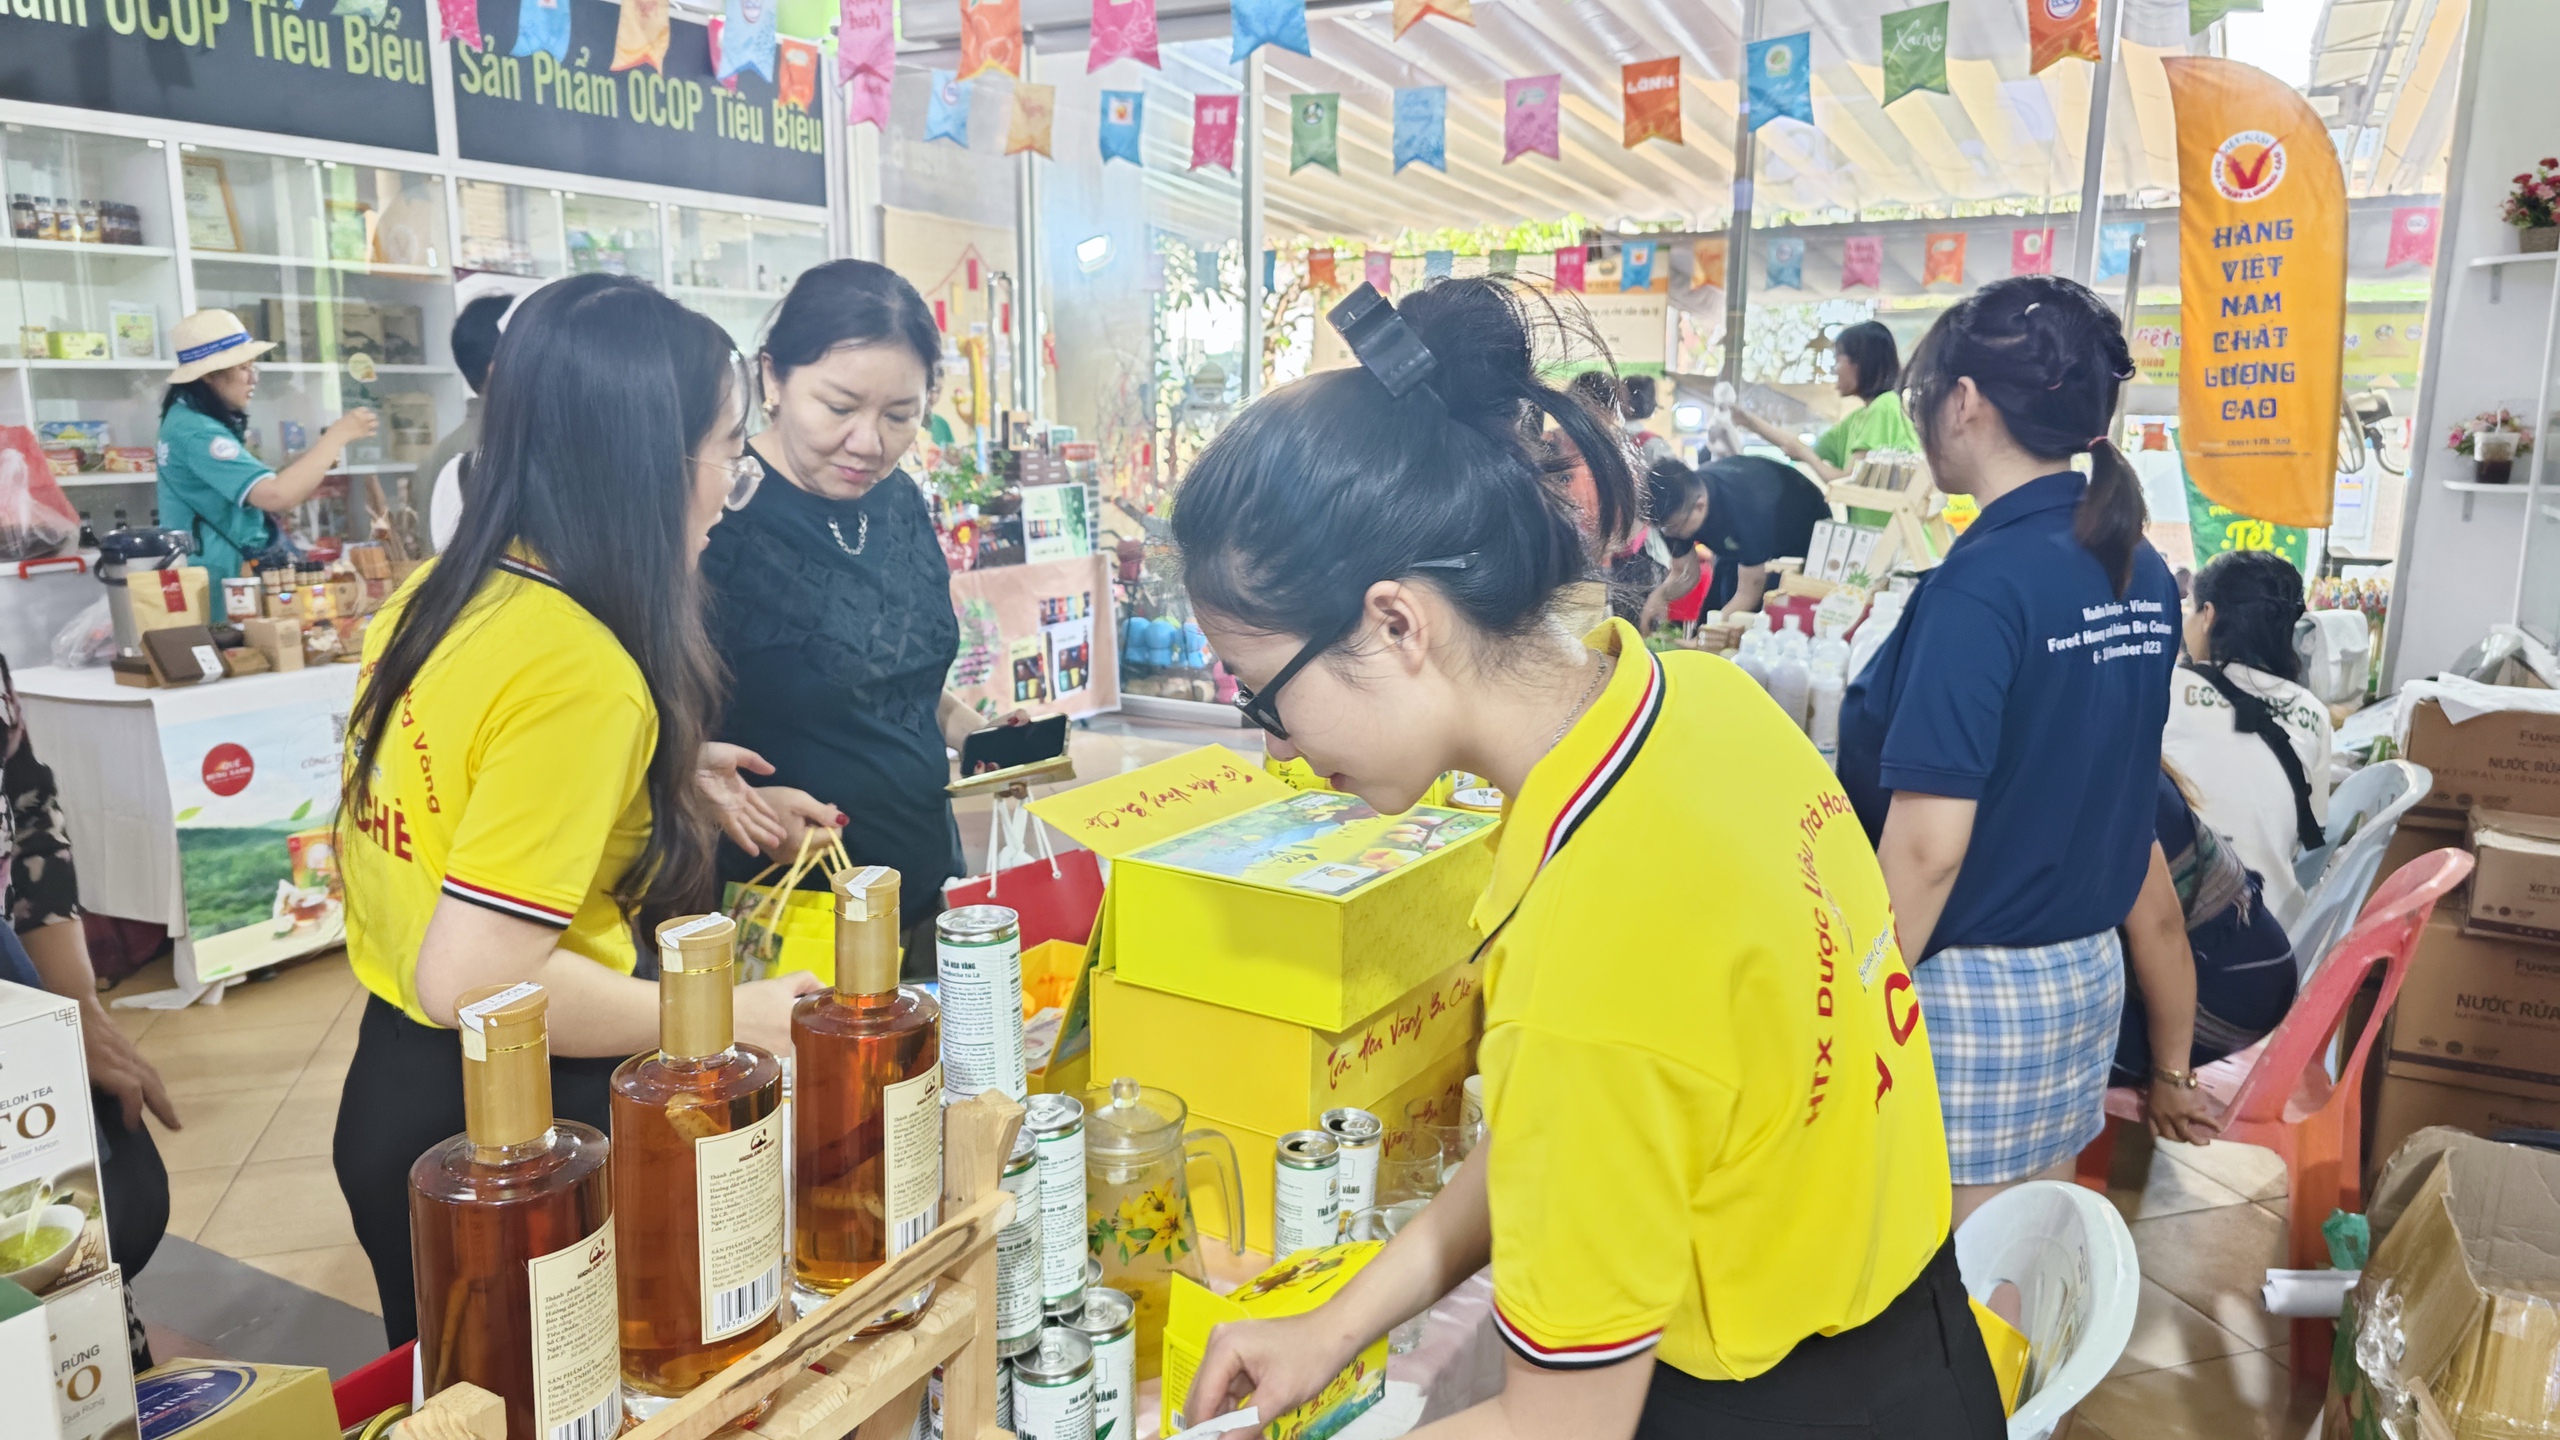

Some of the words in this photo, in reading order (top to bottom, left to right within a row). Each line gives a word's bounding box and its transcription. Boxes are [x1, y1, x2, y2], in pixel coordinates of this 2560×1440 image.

[106, 0, 229, 49] OCOP
[457, 35, 521, 101] Sản
[533, 45, 618, 119] Phẩm
[627, 69, 703, 132] OCOP
[710, 85, 764, 145] Tiêu
[2212, 218, 2294, 249] HÀNG
[2221, 255, 2284, 285] VIỆT
[2221, 291, 2281, 318] NAM
[2213, 320, 2288, 353] CHẤT
[2204, 359, 2295, 391] LƯỢNG
[2222, 397, 2277, 420] CAO
[1816, 790, 1853, 819] Hoa
[1800, 803, 1824, 844] Trà
[1814, 906, 1839, 1018] Dược
[1327, 1047, 1352, 1090] Trà
[1358, 1023, 1383, 1074] Hoa
[1389, 1004, 1424, 1046] Vàng
[1428, 991, 1446, 1020] Ba
[31, 1085, 54, 1099] TEA
[1803, 1034, 1833, 1128] HTX
[34, 1139, 60, 1152] Melon
[1342, 1184, 1360, 1194] VÀNG
[60, 1344, 100, 1374] RỪNG
